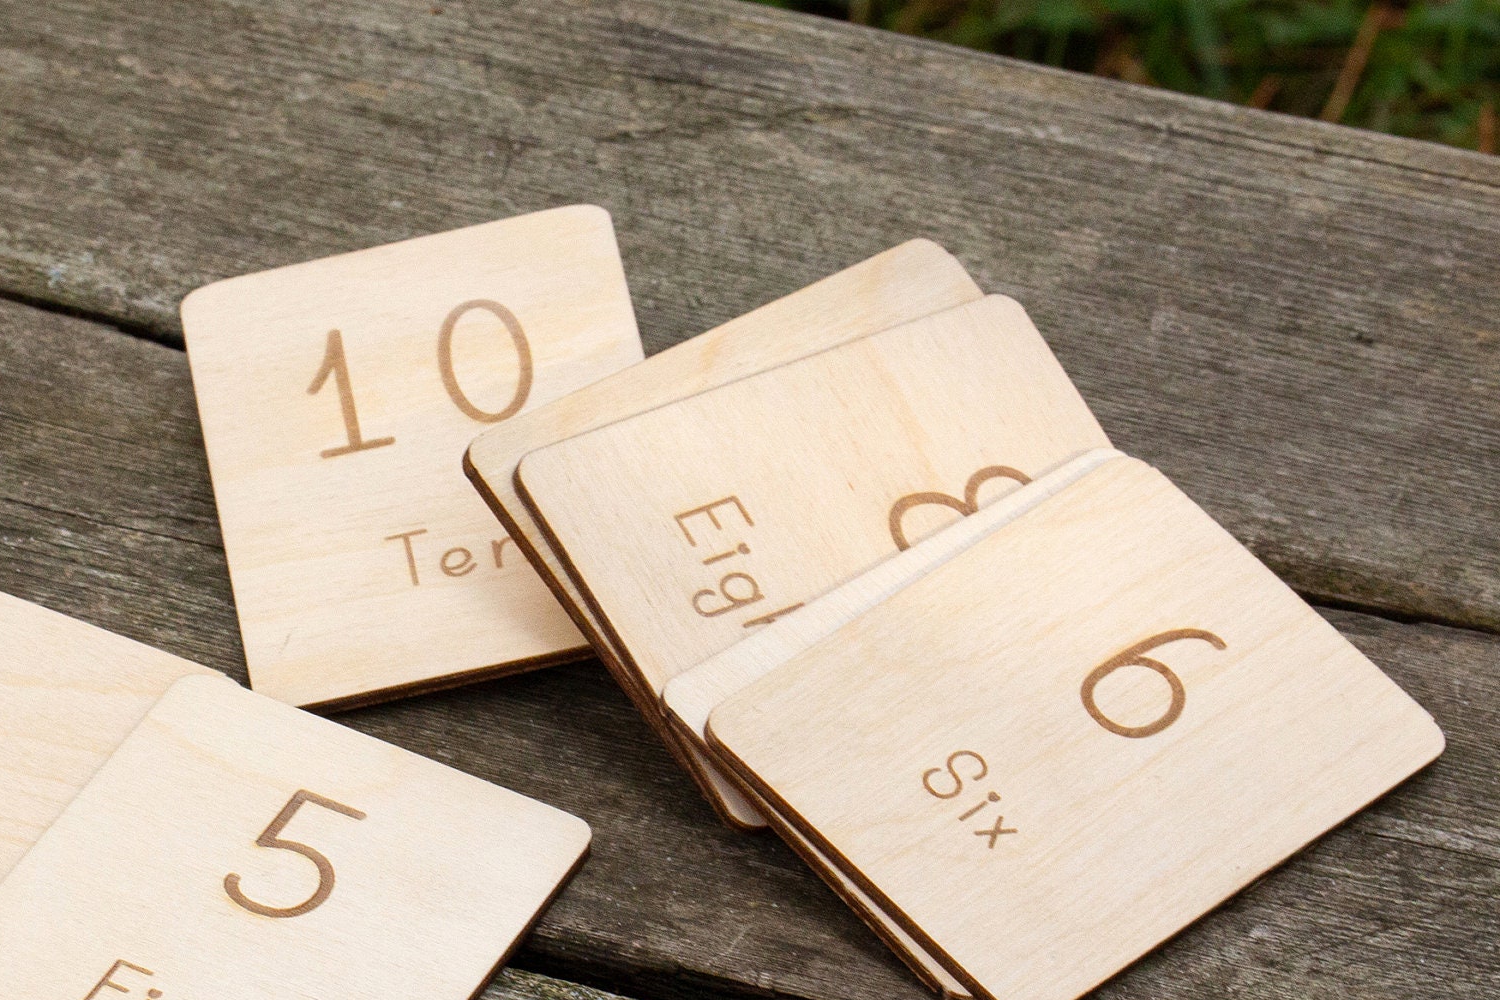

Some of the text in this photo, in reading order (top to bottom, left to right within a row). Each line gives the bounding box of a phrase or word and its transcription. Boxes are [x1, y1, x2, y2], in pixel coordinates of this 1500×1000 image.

[307, 300, 533, 460] 10
[673, 495, 806, 629] Eig
[1080, 627, 1228, 740] 6
[222, 788, 368, 919] 5
[922, 749, 1019, 850] Six
